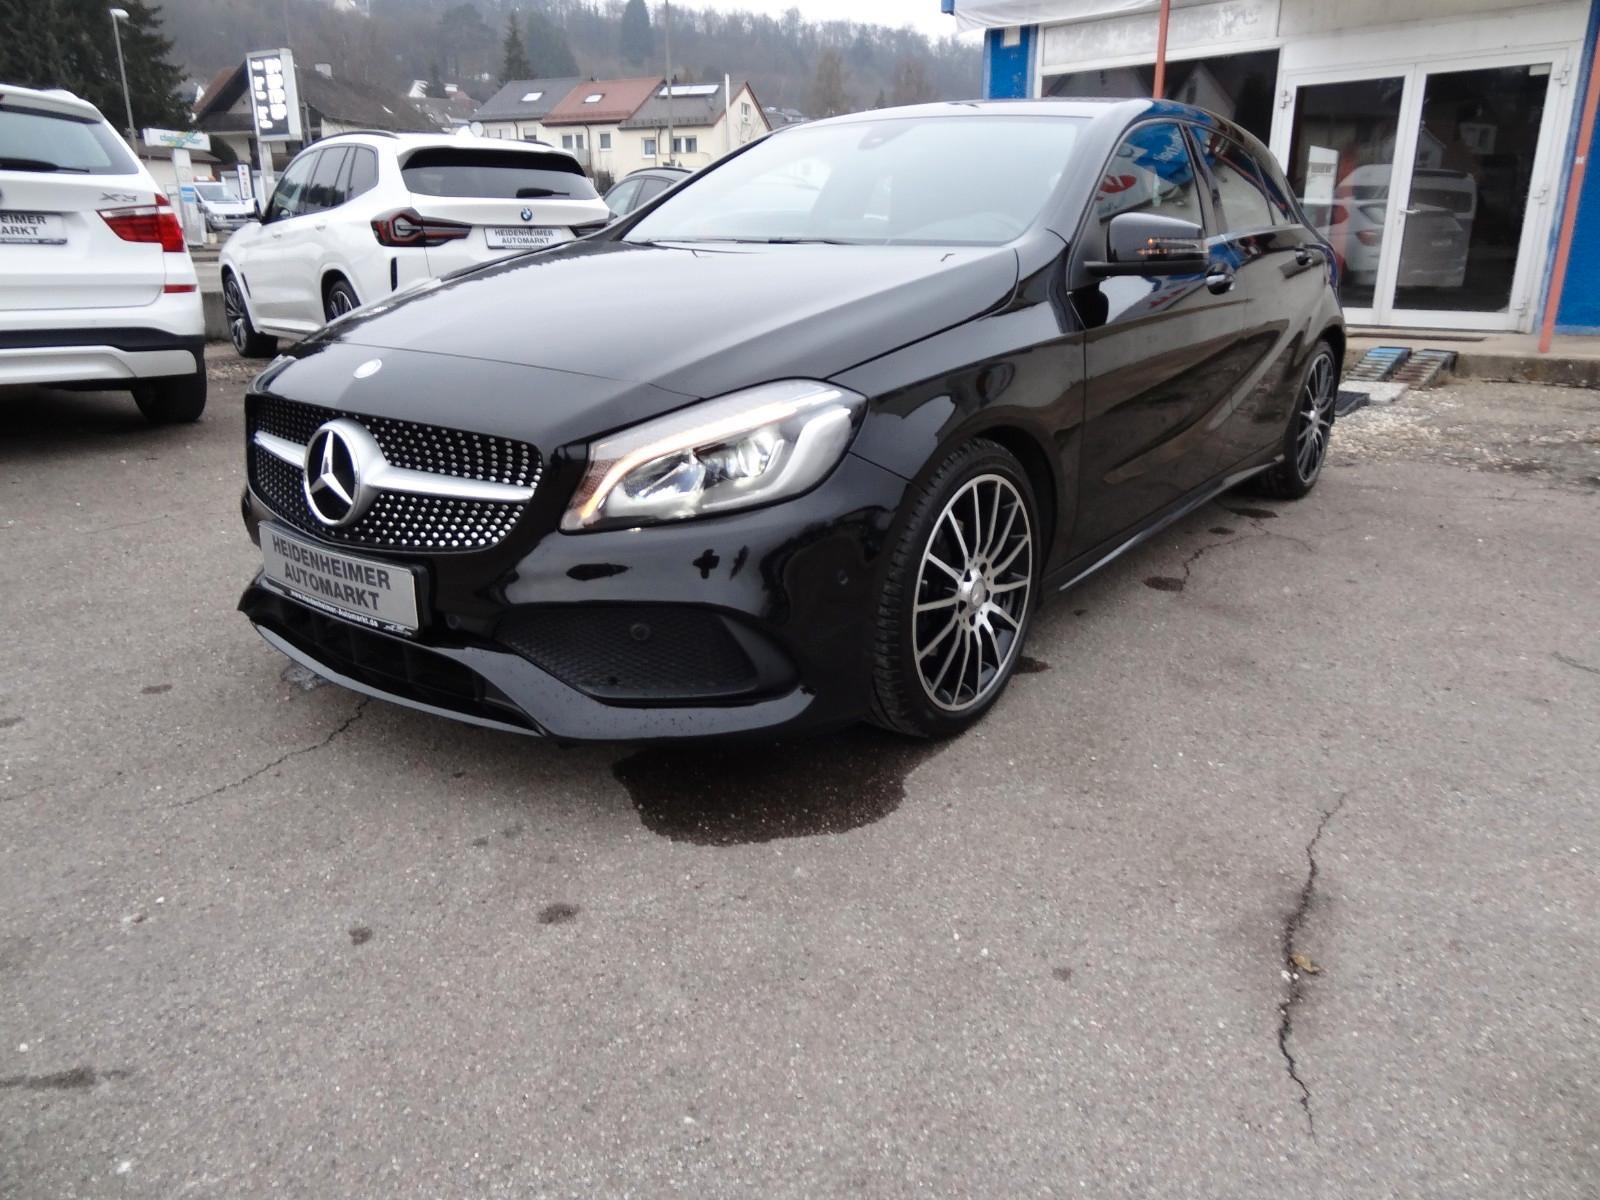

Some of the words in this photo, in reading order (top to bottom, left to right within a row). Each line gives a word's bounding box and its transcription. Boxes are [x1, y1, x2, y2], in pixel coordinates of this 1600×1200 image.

[494, 229, 554, 237] HEIDENHEIMER
[271, 534, 391, 590] HEIDENHEIMER
[284, 561, 380, 610] AUTOMARKT
